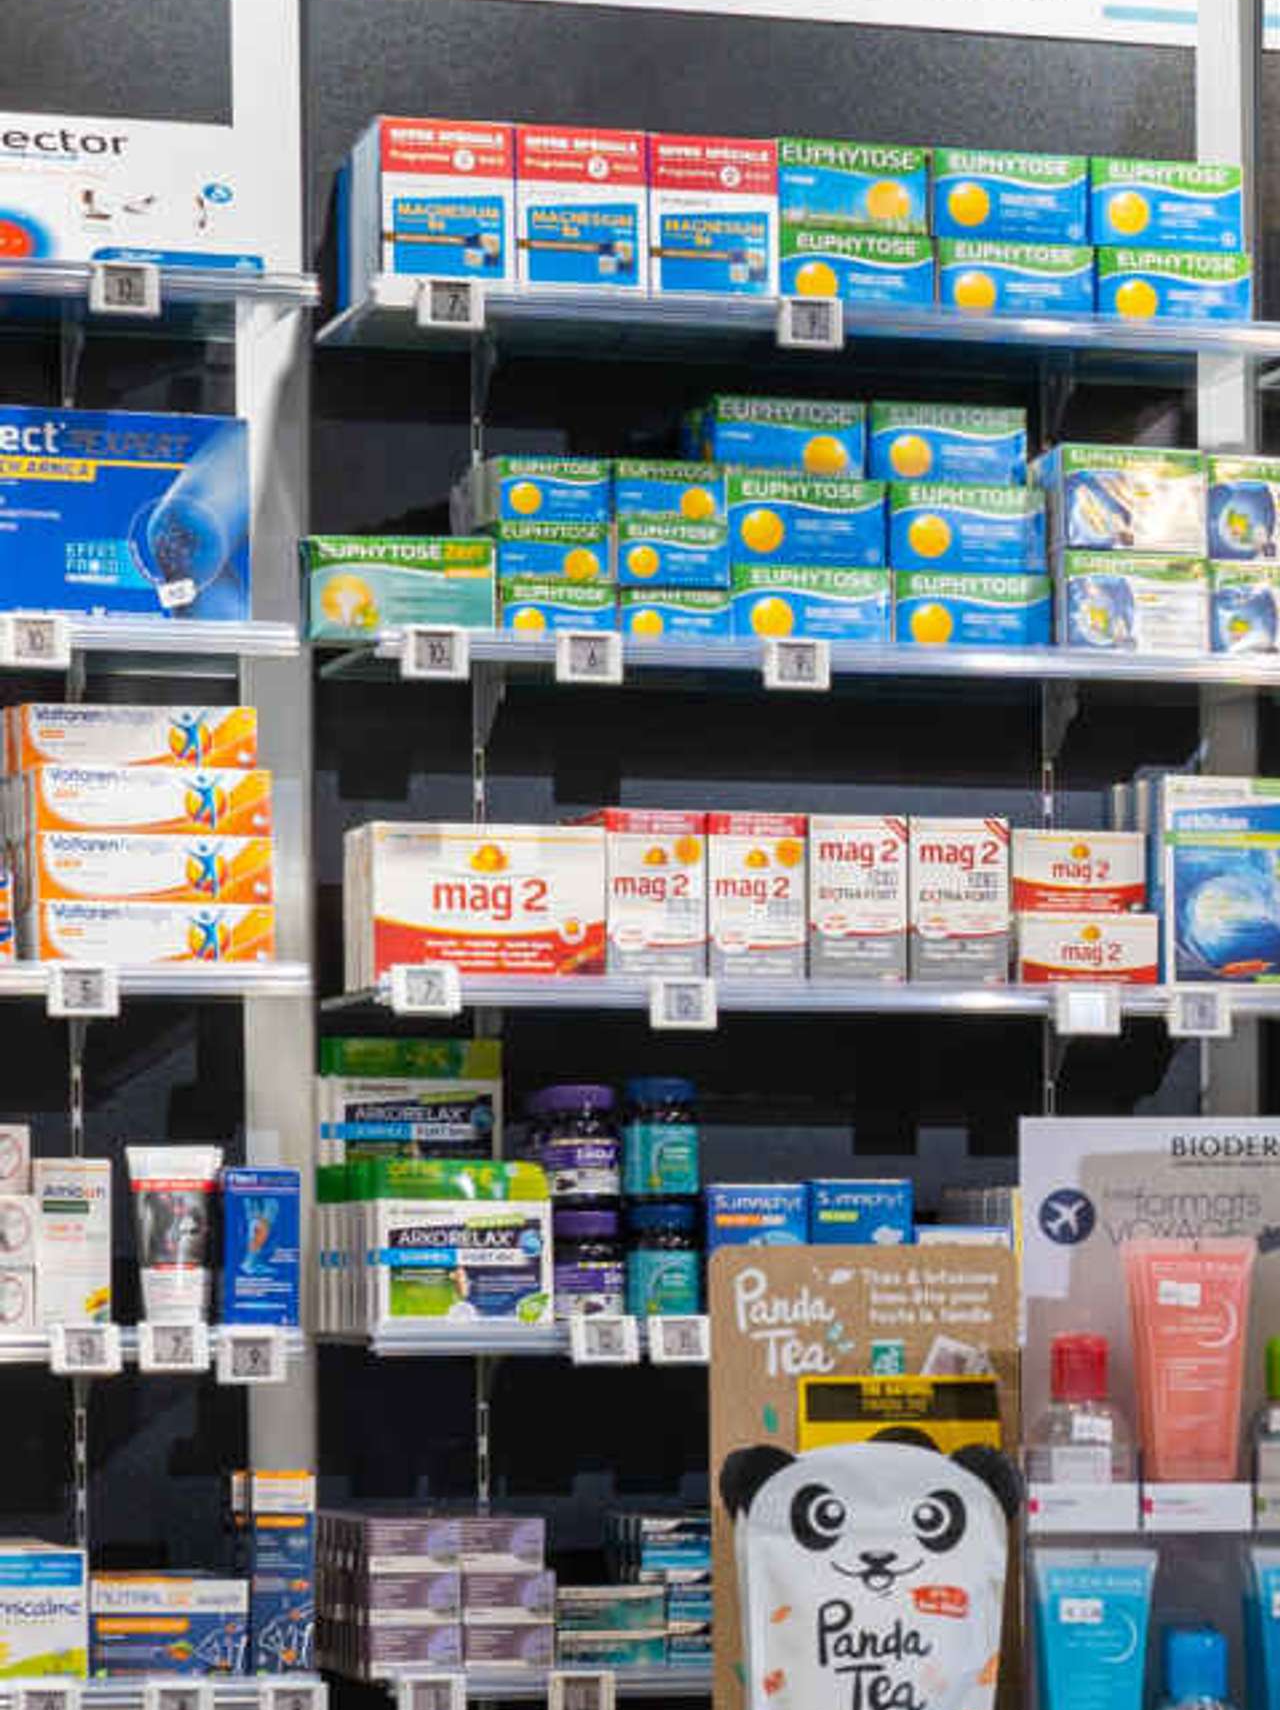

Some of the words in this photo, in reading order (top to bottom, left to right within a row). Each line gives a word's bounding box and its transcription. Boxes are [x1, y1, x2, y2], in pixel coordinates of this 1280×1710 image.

[818, 841, 875, 868] mag
[881, 839, 900, 863] 2
[919, 843, 975, 870] mag
[980, 841, 1000, 865] 2
[1050, 860, 1090, 884] mag
[1095, 861, 1110, 880] 2
[432, 879, 511, 920] mag
[522, 880, 548, 912] 2
[614, 876, 666, 902] mag
[671, 874, 690, 896] 2
[715, 878, 767, 904] mag
[772, 876, 791, 899] 2
[1061, 942, 1101, 966] mag
[1106, 941, 1121, 963] 2
[397, 1228, 514, 1247] ARKORELAX
[734, 1266, 835, 1333] Panda
[750, 1327, 836, 1377] Tea
[817, 1598, 932, 1668] Panda
